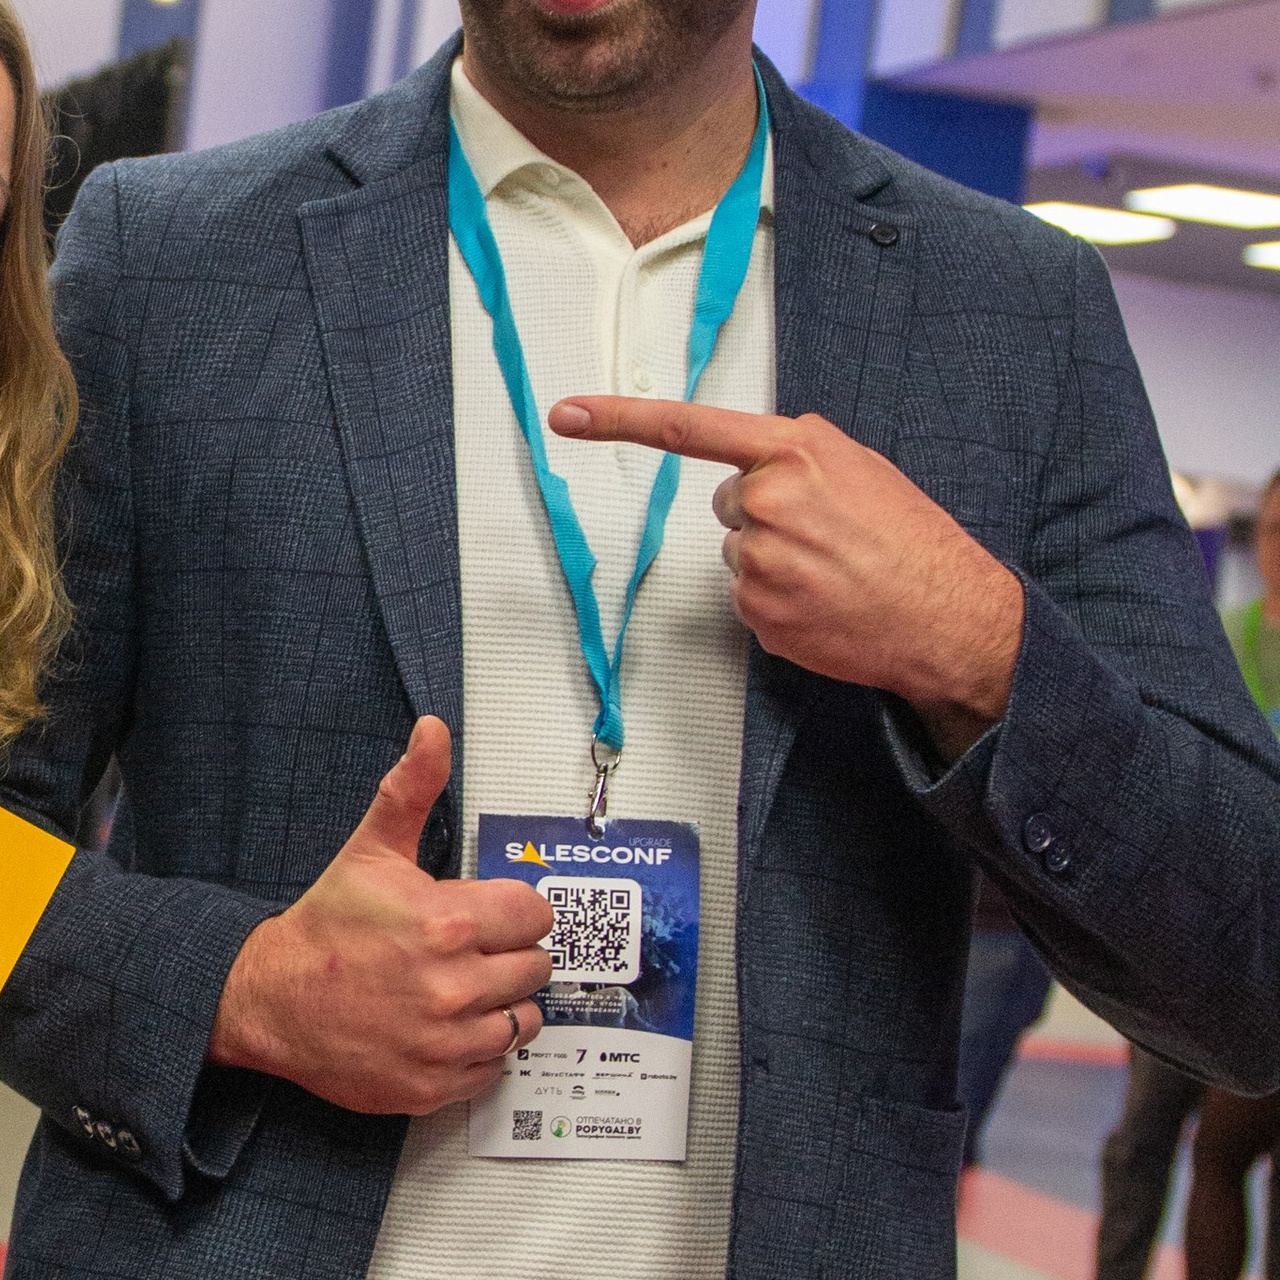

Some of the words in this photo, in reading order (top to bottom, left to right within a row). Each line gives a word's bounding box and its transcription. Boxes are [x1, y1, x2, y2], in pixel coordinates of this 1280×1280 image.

[629, 837, 672, 847] UPGRADE
[576, 1115, 635, 1125] ОТПЕЧАТАНО
[576, 1125, 642, 1135] POPYGAI.BY
